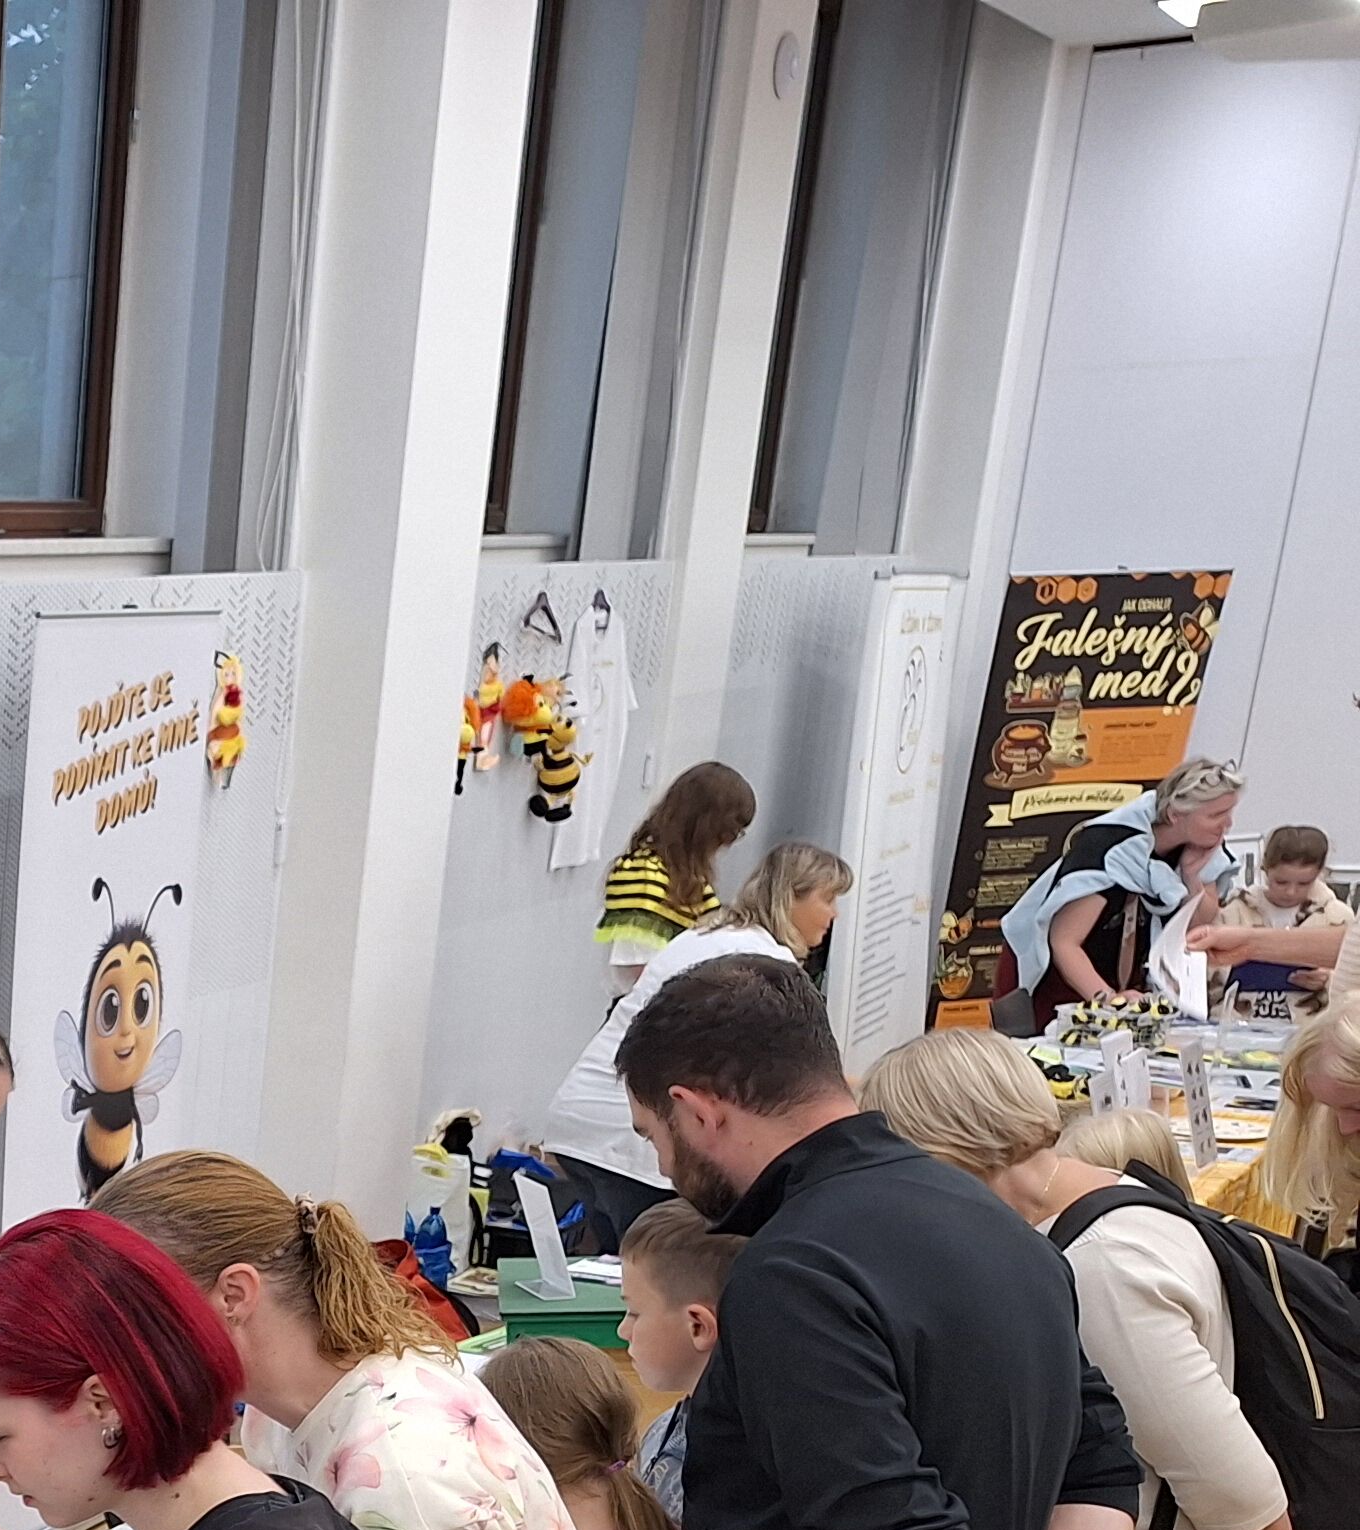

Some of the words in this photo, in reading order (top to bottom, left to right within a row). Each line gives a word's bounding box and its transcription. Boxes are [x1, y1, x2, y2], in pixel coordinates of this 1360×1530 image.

[1014, 607, 1175, 670] Falešný
[148, 671, 174, 712] SE
[131, 728, 155, 769] KE
[95, 768, 157, 835] DOMŮ!
